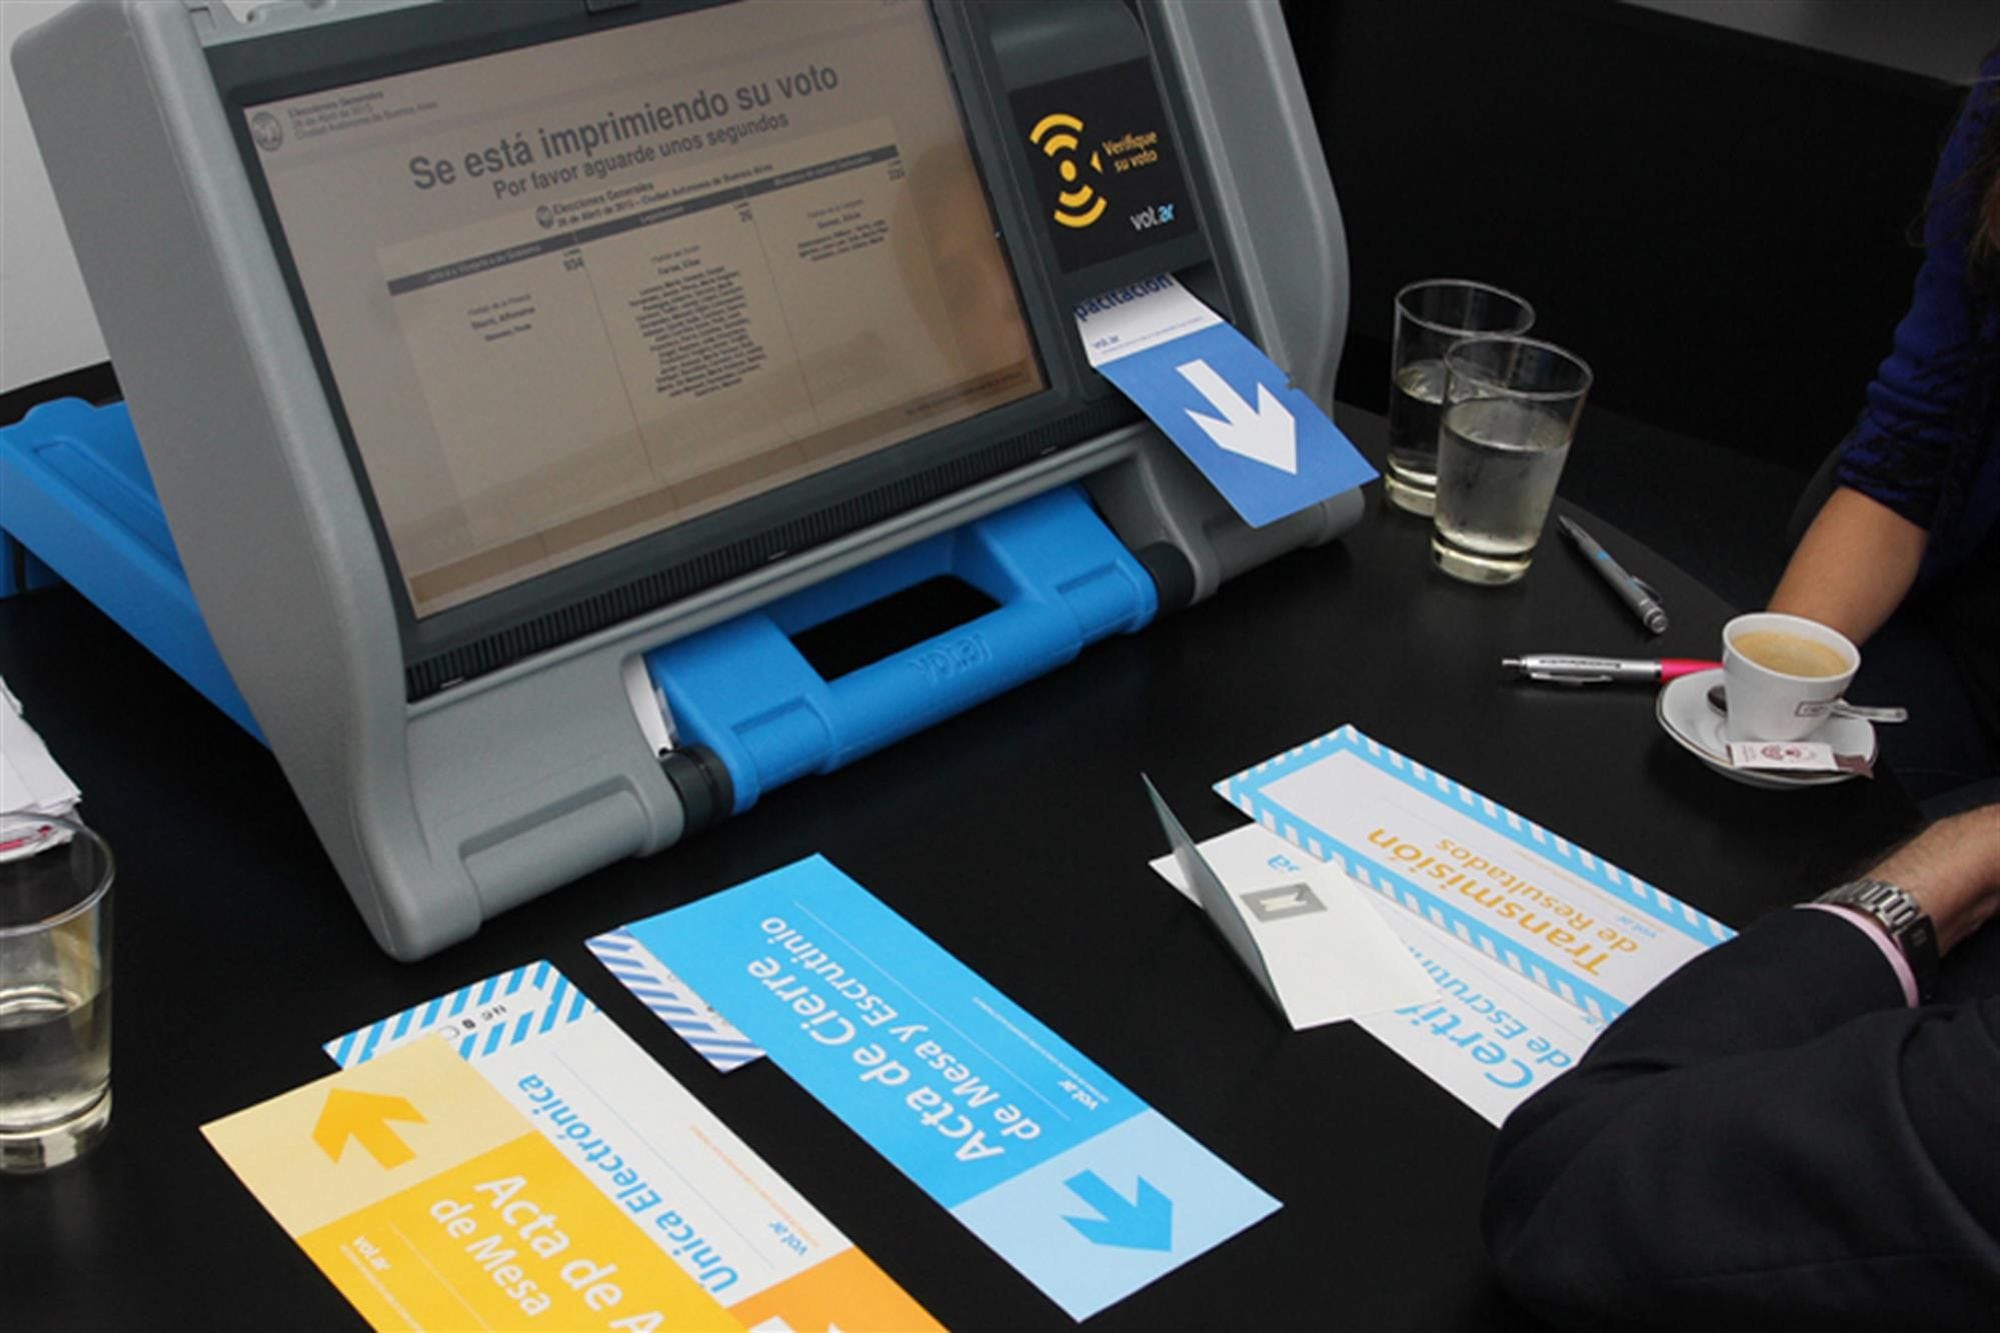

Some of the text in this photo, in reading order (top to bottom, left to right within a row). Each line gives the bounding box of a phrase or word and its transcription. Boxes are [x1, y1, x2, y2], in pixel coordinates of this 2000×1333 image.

[408, 63, 839, 190] Se está imprimiendo su voto
[493, 113, 789, 200] Por favor aguarde unos segundos
[1102, 131, 1157, 156] Verifique
[1114, 150, 1158, 172] su voto
[1367, 828, 1609, 977] Transmisión
[1436, 838, 1594, 932] Resultados
[760, 916, 898, 1028] Escrutinio
[1597, 928, 1638, 953] de
[747, 956, 856, 1046] Cierre
[889, 1023, 928, 1043] y
[852, 1043, 911, 1086] de
[914, 1040, 999, 1109] Mesa
[1526, 1036, 1572, 1068] de
[906, 1086, 1005, 1162] Acta
[994, 1102, 1042, 1143] de
[430, 1199, 552, 1317] de Mesa
[473, 1174, 571, 1259] Acta
[560, 1258, 624, 1312] de
